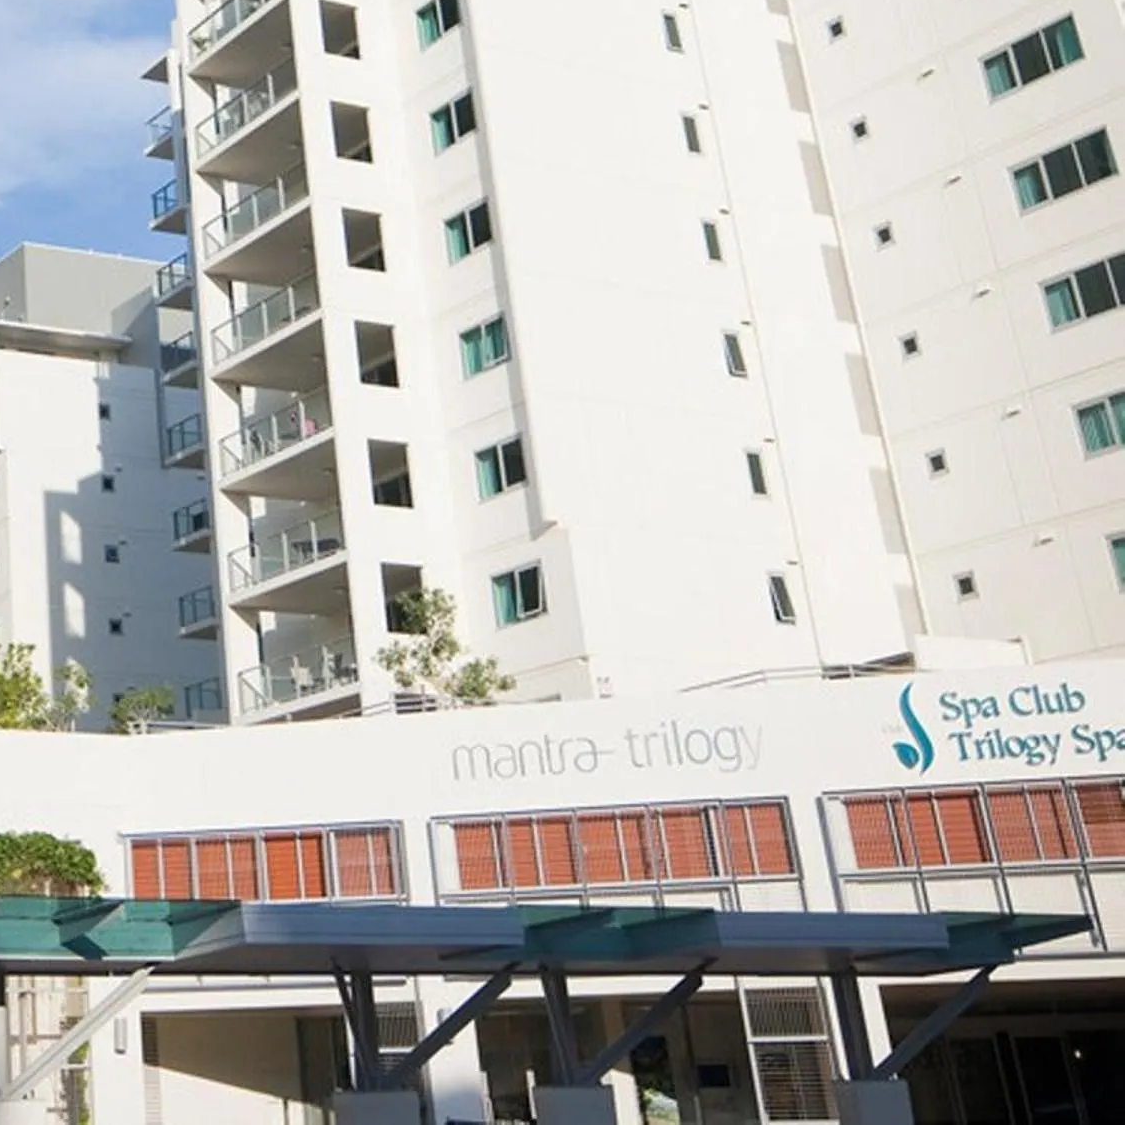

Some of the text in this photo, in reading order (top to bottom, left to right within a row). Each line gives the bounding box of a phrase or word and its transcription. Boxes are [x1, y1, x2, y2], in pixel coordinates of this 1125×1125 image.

[938, 682, 1086, 728] Spa Club
[623, 719, 764, 774] trilogy
[948, 728, 1061, 767] Trilogy
